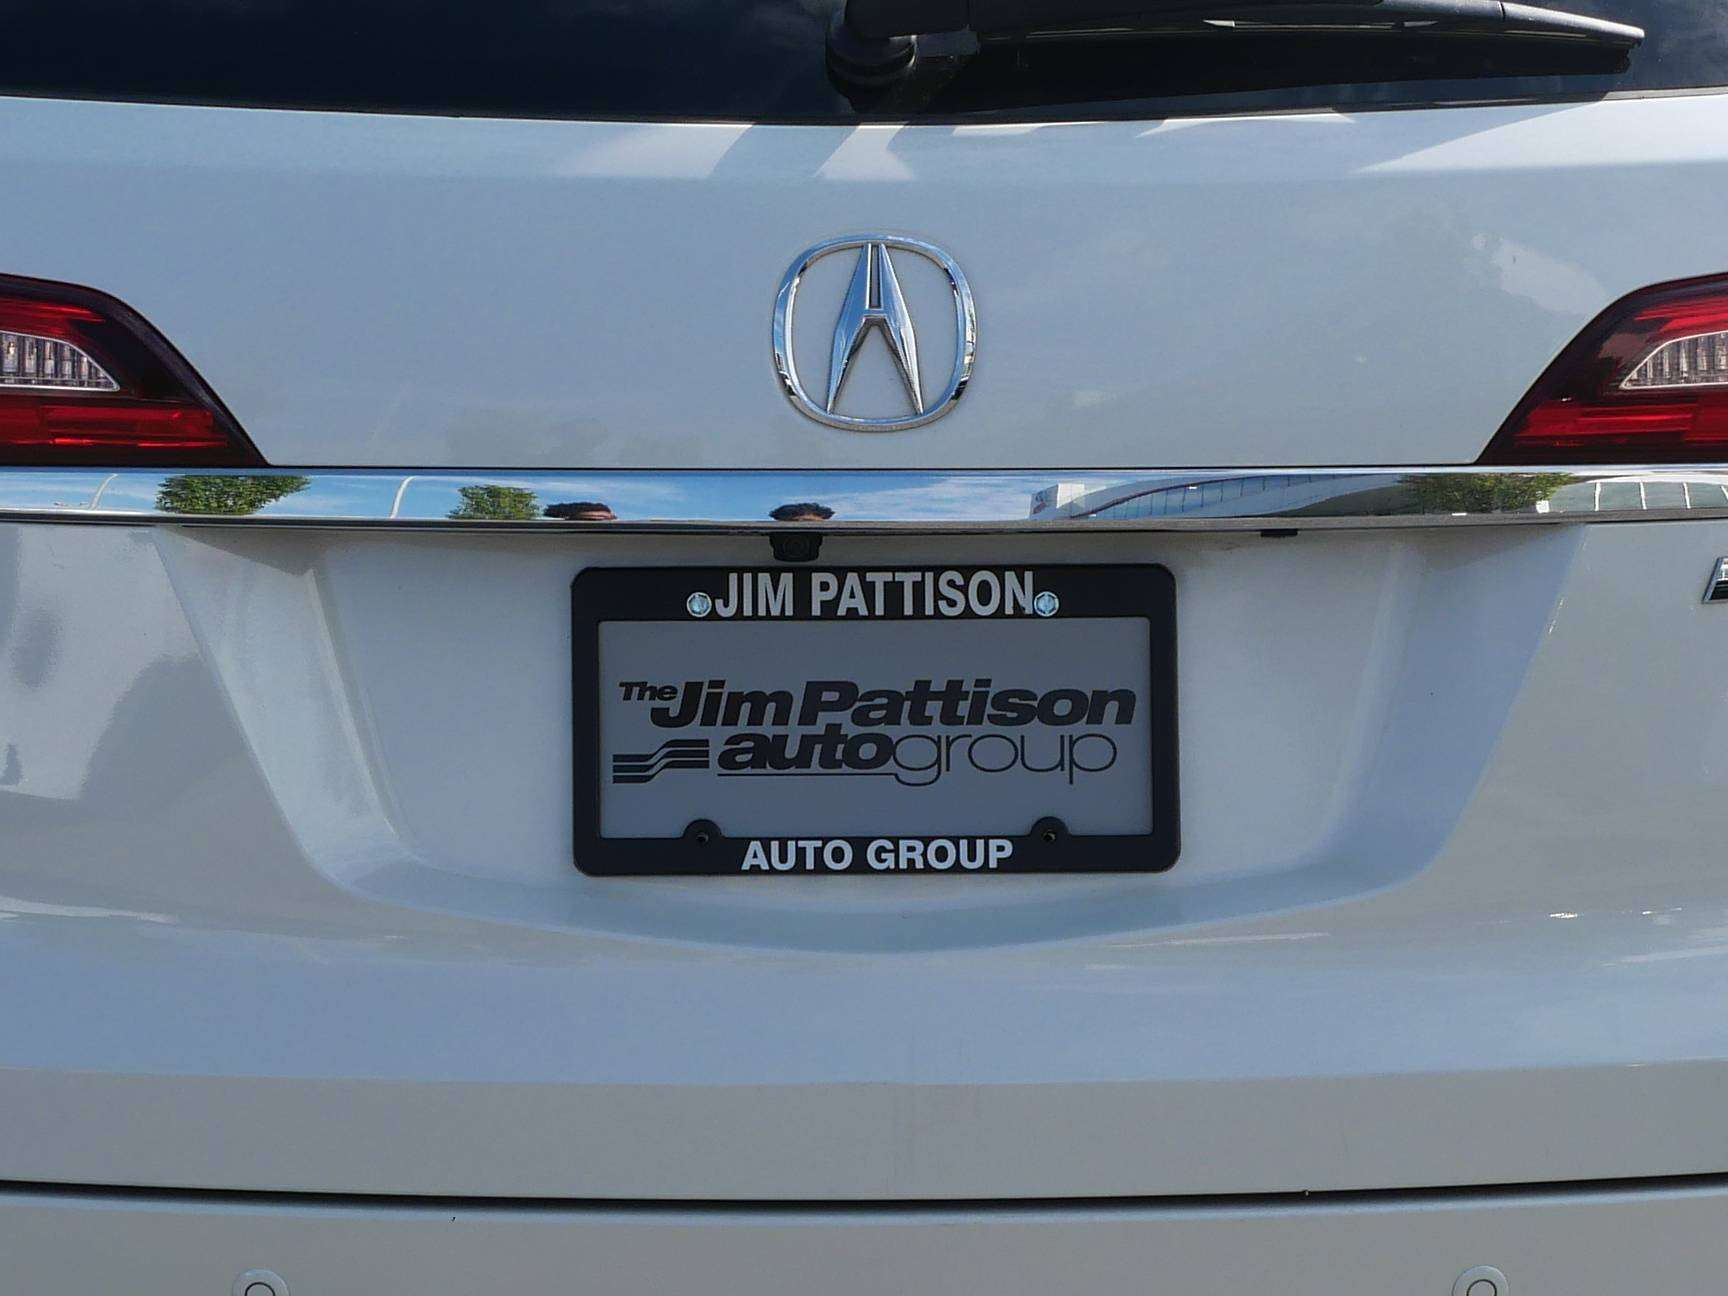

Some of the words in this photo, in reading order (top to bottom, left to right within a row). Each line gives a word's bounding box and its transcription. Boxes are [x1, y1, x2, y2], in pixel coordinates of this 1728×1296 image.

[715, 572, 793, 617] JIM
[811, 570, 1034, 617] PATTISON
[619, 681, 678, 702] The
[650, 679, 794, 728] Jim
[797, 678, 1136, 728] Pattison
[741, 840, 854, 871] AUTO
[867, 838, 1014, 871] GROUP
